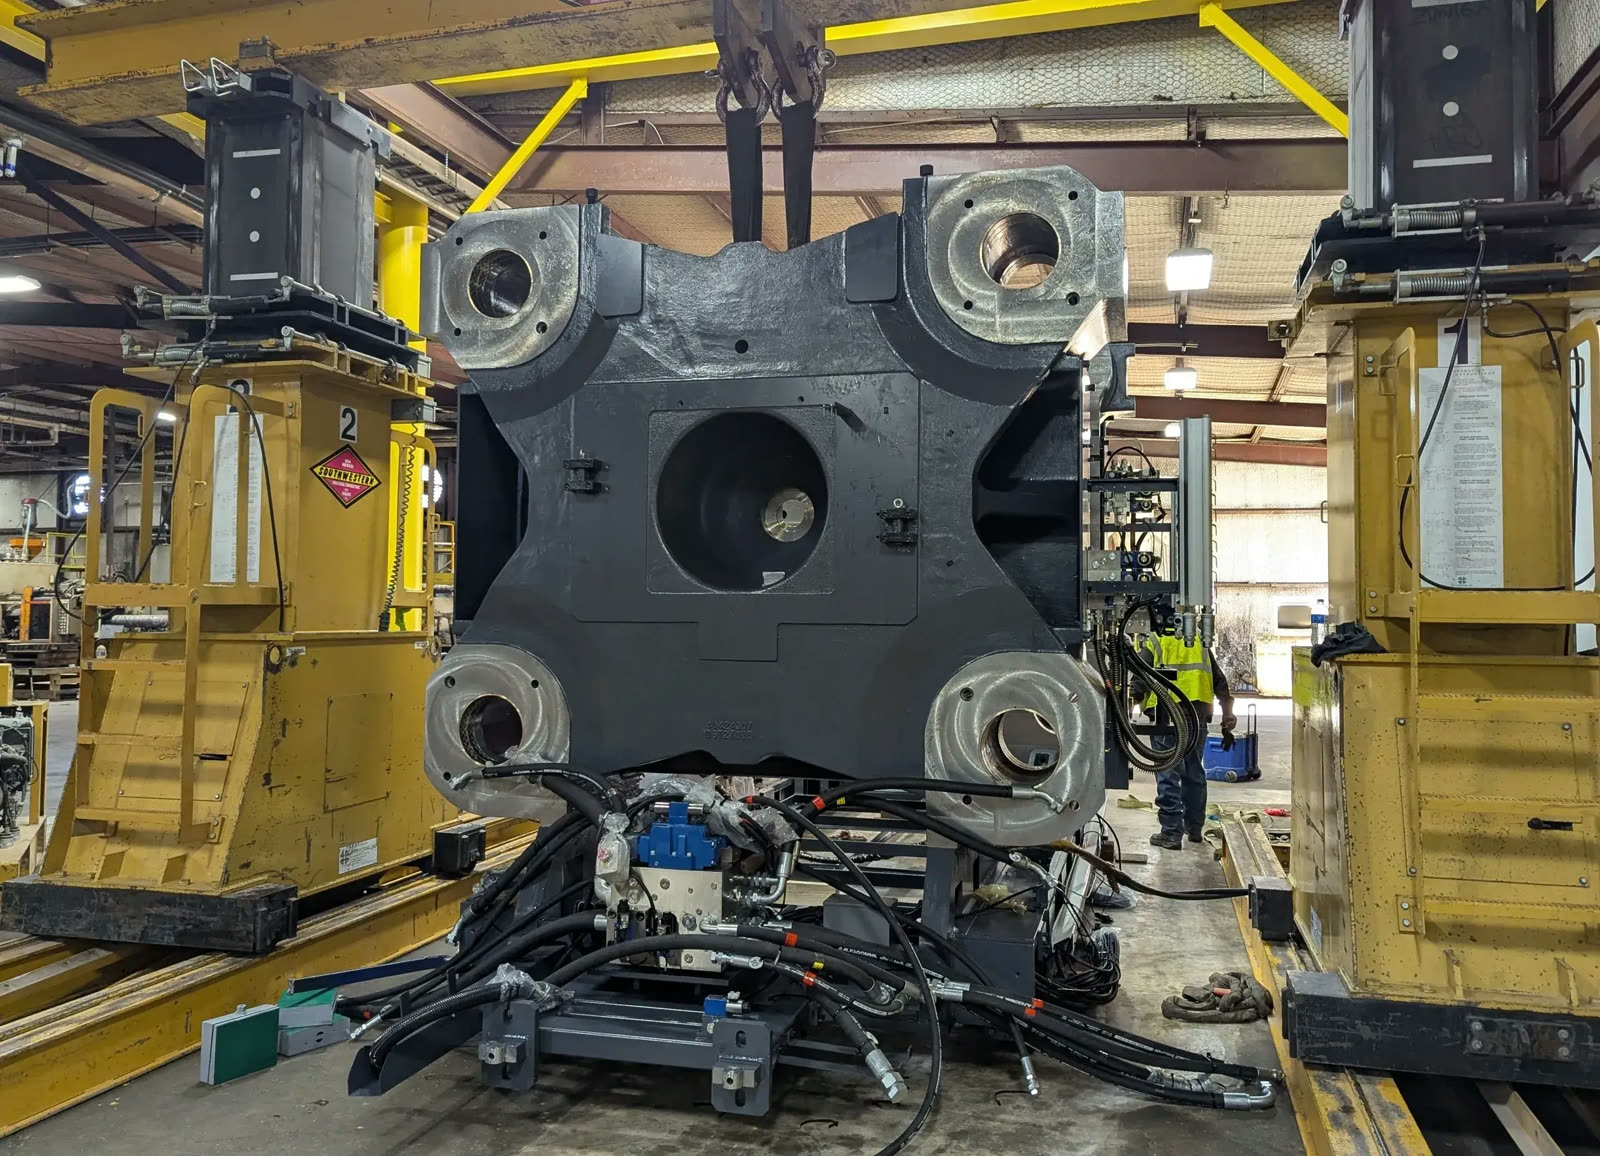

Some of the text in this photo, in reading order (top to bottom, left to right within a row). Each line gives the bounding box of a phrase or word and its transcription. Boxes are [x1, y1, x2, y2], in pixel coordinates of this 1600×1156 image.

[1444, 319, 1468, 364] 1
[341, 407, 356, 441] 2
[318, 466, 375, 485] SOUTHWESTERN
